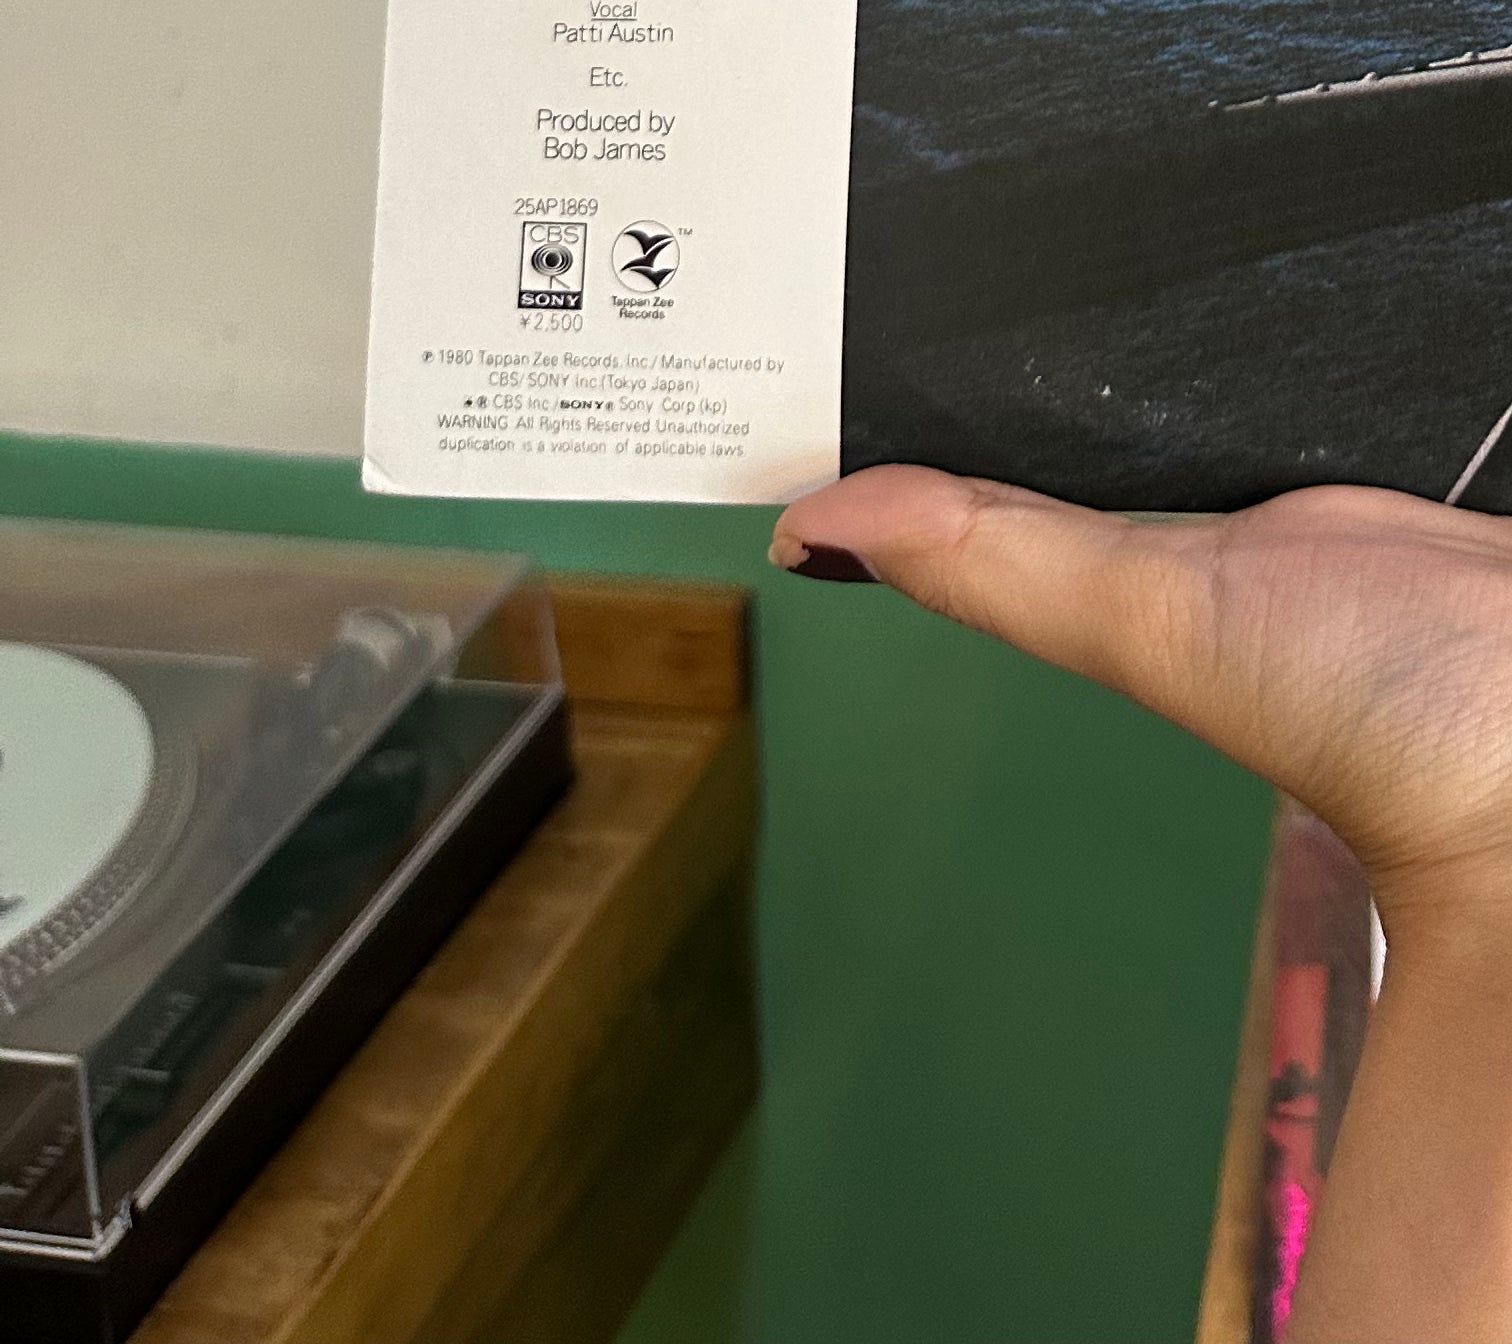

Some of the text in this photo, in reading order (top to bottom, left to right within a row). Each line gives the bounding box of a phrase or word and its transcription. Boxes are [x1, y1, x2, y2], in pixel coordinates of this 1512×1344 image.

[589, 0, 638, 18] Vocal
[552, 22, 674, 43] Patti Austin
[589, 66, 629, 88] Etc.
[536, 108, 676, 137] Produced by
[543, 136, 667, 161] Bob James
[529, 224, 580, 244] CBS
[520, 292, 581, 307] SONY
[619, 307, 666, 320] Records
[438, 348, 474, 366] 1980
[478, 349, 530, 368] Tappan
[532, 350, 559, 367] Zee
[767, 356, 785, 374] by
[492, 393, 523, 411] CBS
[618, 395, 654, 414] Sony
[515, 414, 534, 430] All
[539, 415, 582, 434] Rights
[438, 435, 515, 453] duplication
[537, 440, 546, 452] a
[550, 439, 607, 454] violation
[614, 438, 630, 455] of
[634, 440, 707, 457] applicable
